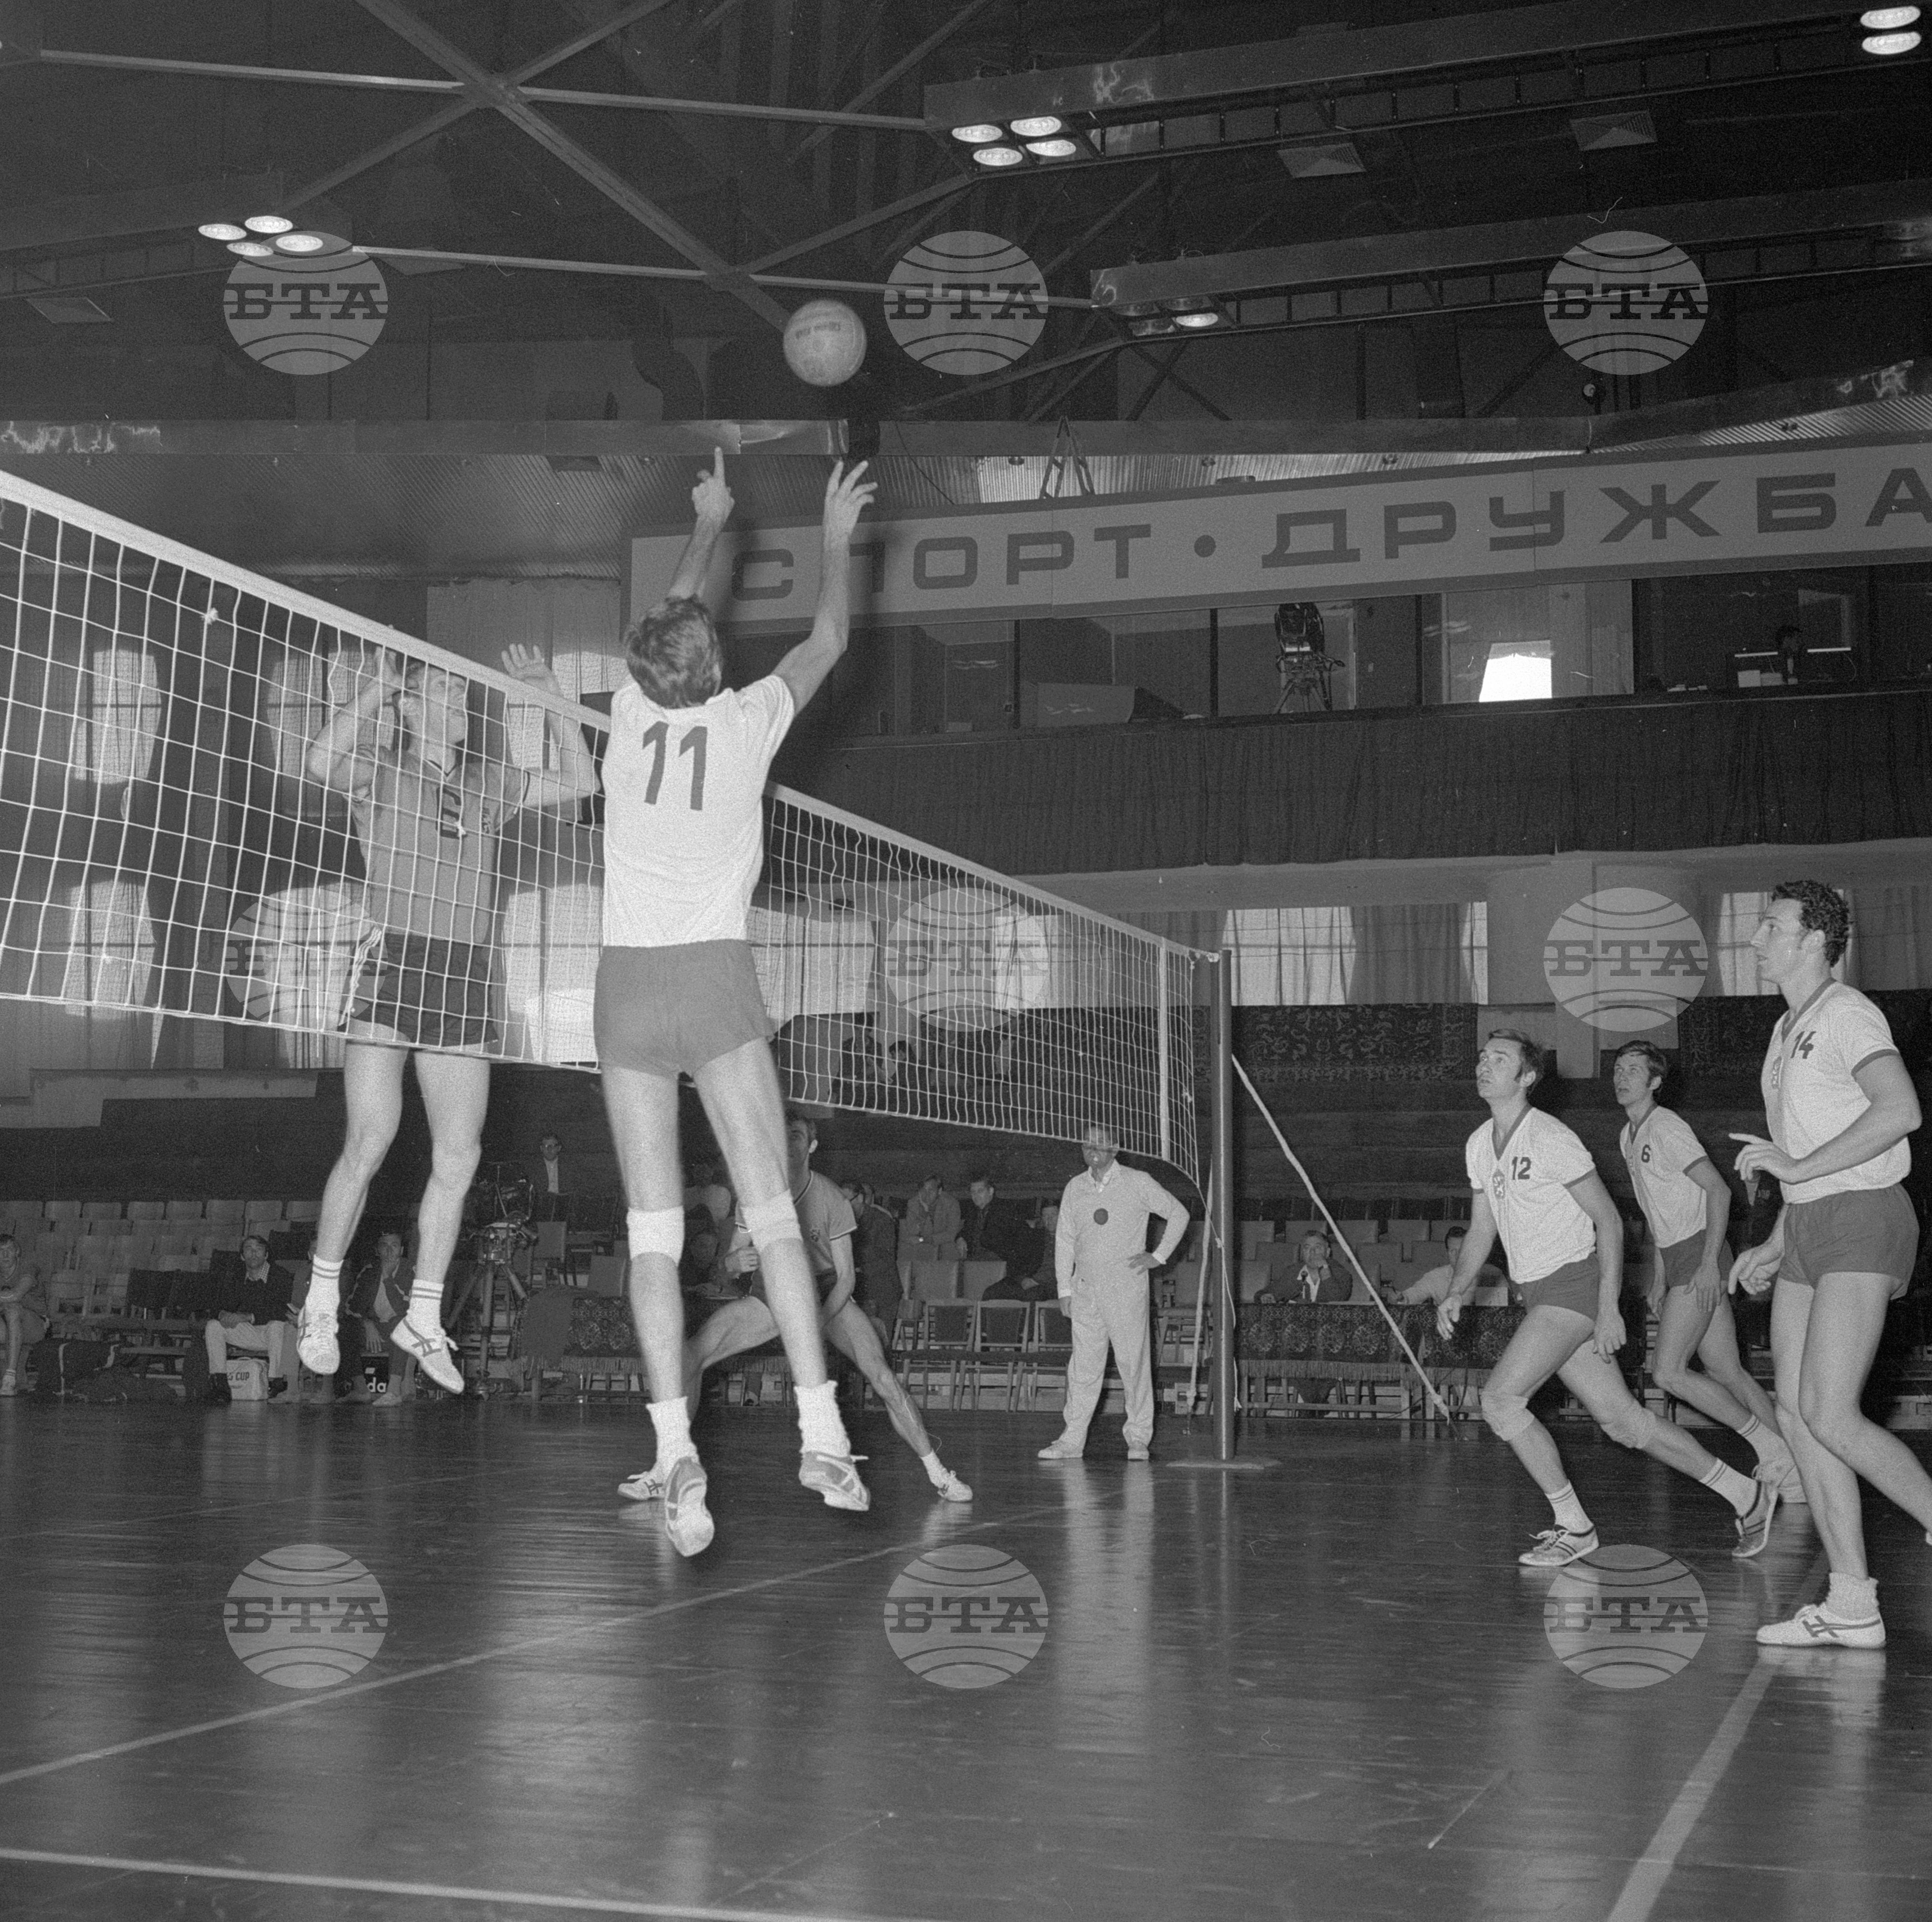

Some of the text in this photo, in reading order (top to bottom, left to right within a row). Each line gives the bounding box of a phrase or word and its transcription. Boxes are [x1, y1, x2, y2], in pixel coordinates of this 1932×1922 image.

[1262, 467, 1932, 568] ДРУЖБА
[642, 720, 708, 811] 11
[1790, 1031, 1816, 1060] 14
[1641, 1144, 1651, 1163] 6
[1511, 1156, 1531, 1180] 12
[236, 1371, 250, 1381] CUP
